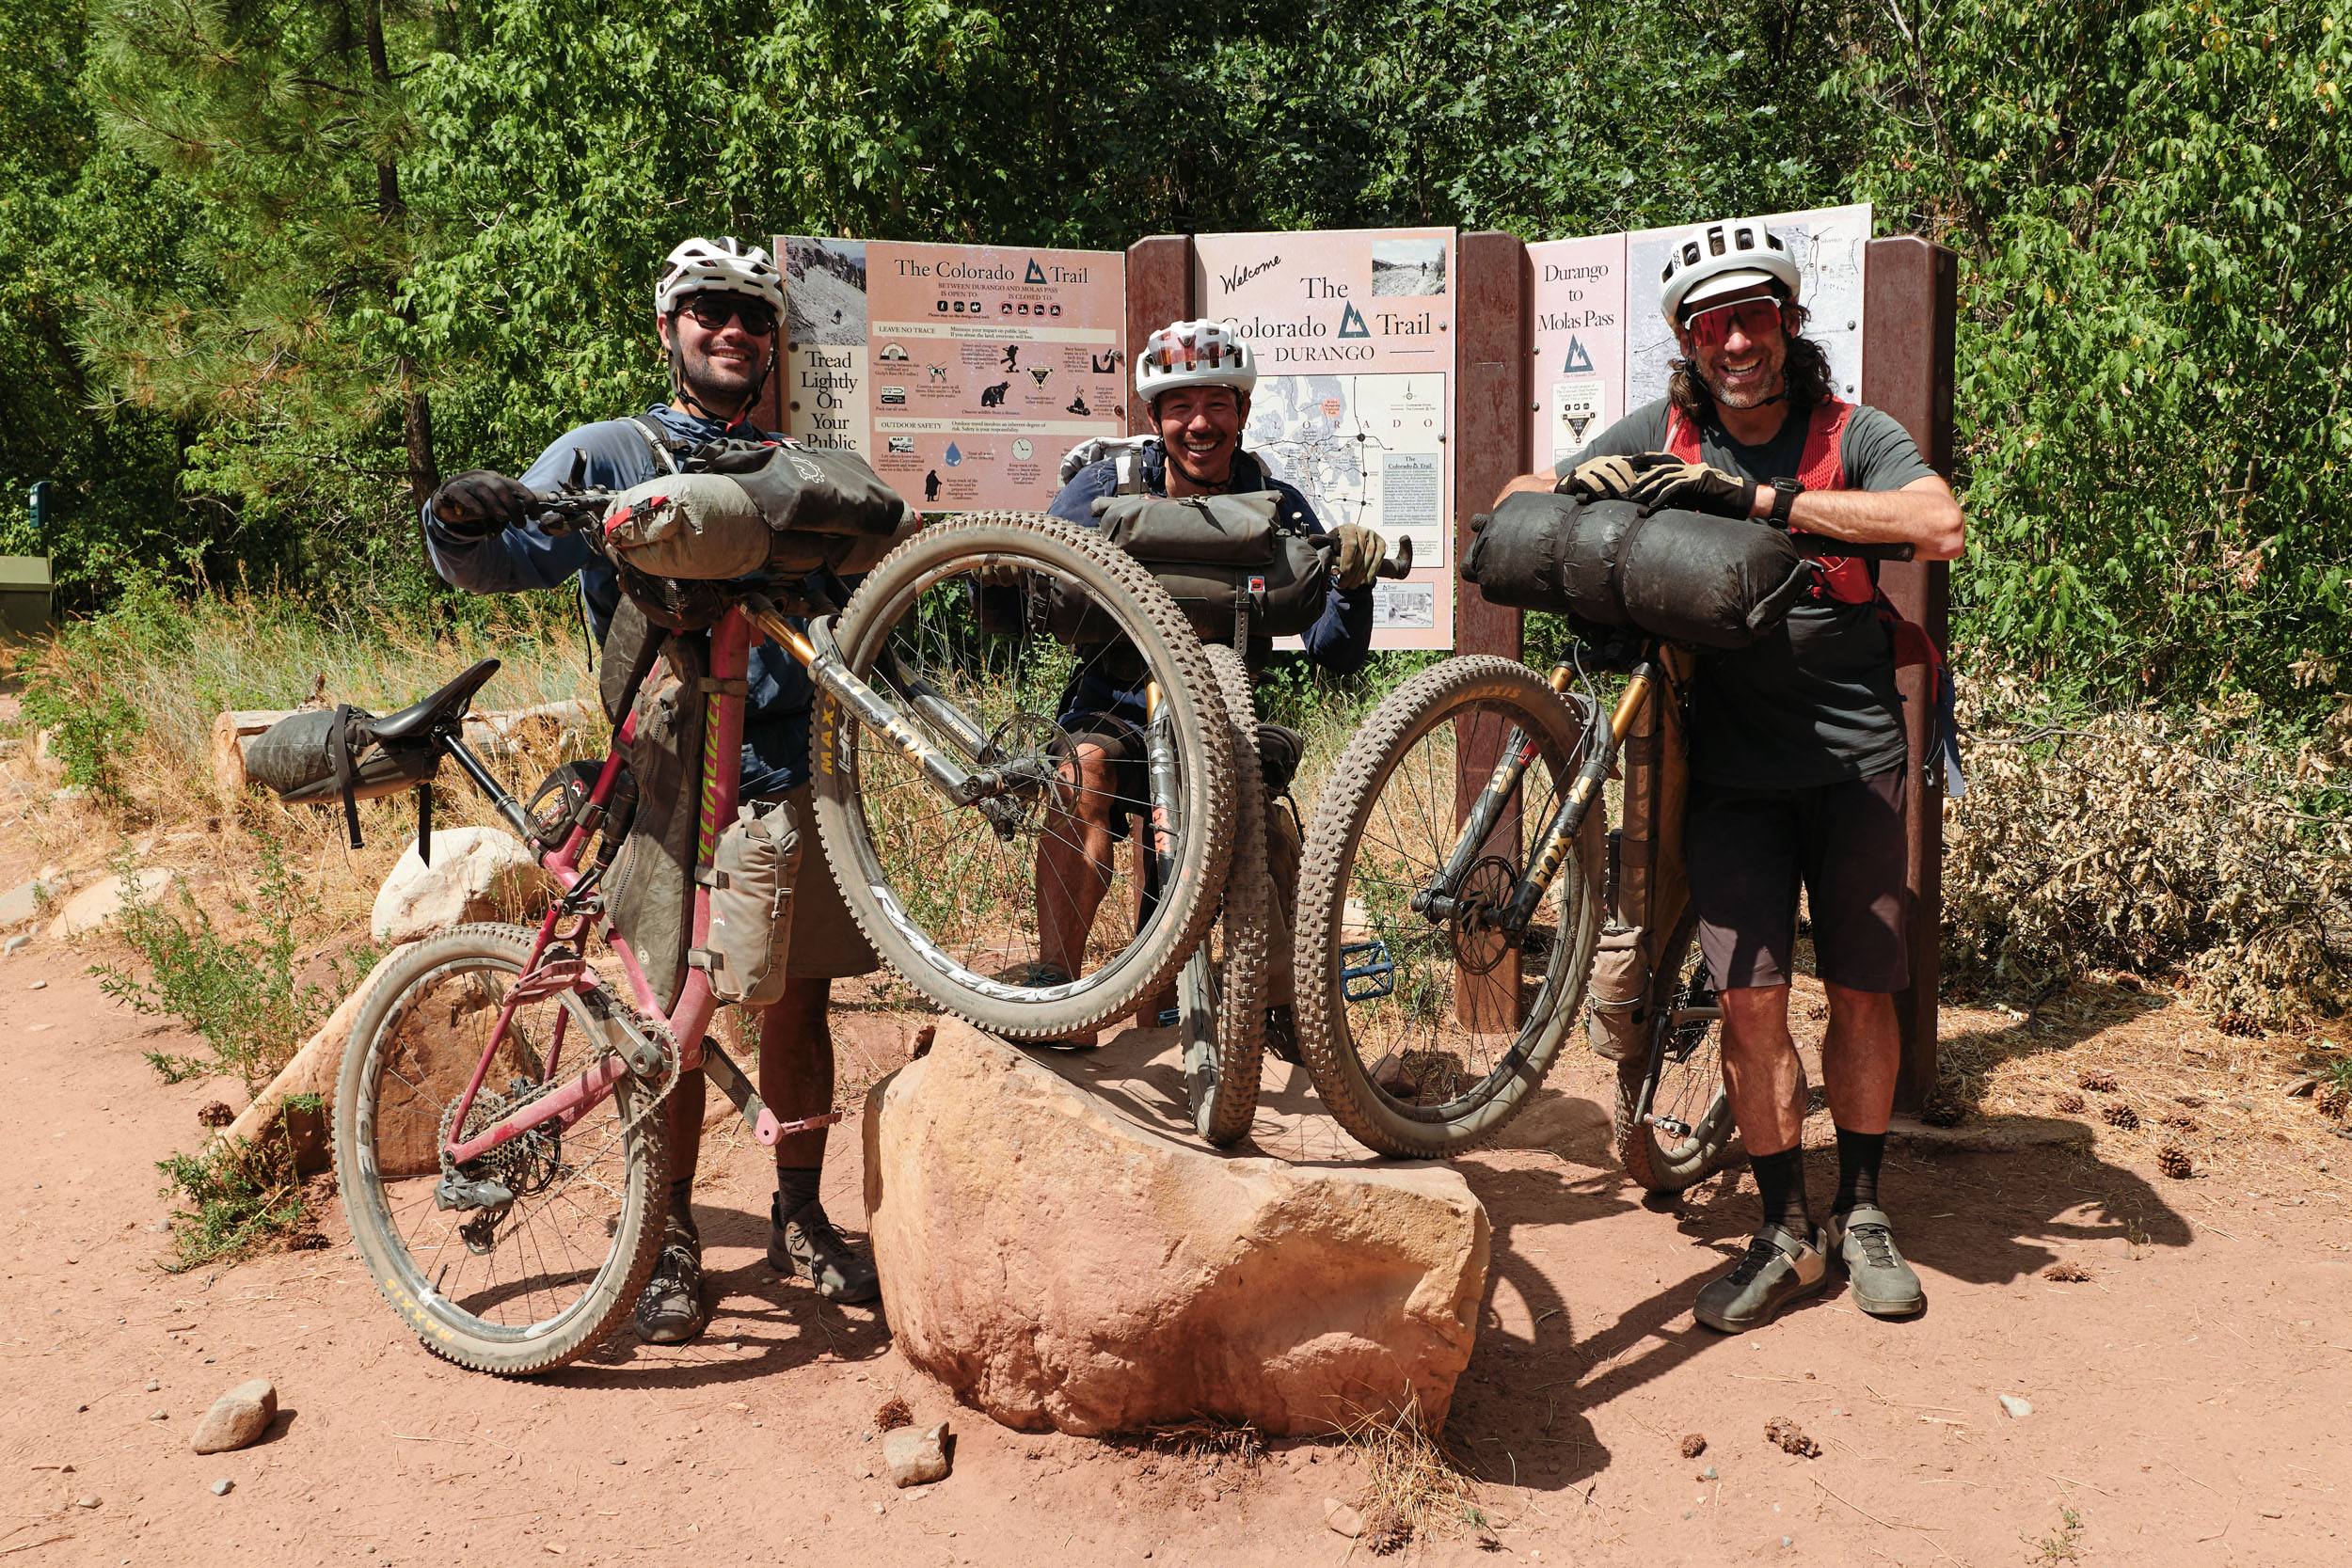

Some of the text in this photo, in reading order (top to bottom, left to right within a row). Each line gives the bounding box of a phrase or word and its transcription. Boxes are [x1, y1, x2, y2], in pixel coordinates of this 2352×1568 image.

[895, 259, 1089, 283] The Colorado Trail
[1220, 255, 1281, 295] Welcome
[1544, 264, 1609, 283] Durango
[1300, 277, 1349, 299] The
[1568, 288, 1583, 302] to
[1376, 312, 1431, 336] Trail
[1538, 310, 1614, 332] Molas Pass
[805, 350, 851, 368] Tread
[1275, 345, 1375, 362] DURANGO
[801, 372, 858, 394] Lightly
[817, 392, 843, 409] On
[811, 413, 850, 430] Your
[806, 433, 857, 450] Public
[881, 716, 938, 769] FOX
[949, 721, 976, 744] FACTORY
[1526, 827, 1574, 889] FOX
[384, 1278, 455, 1343] MAXXIS
